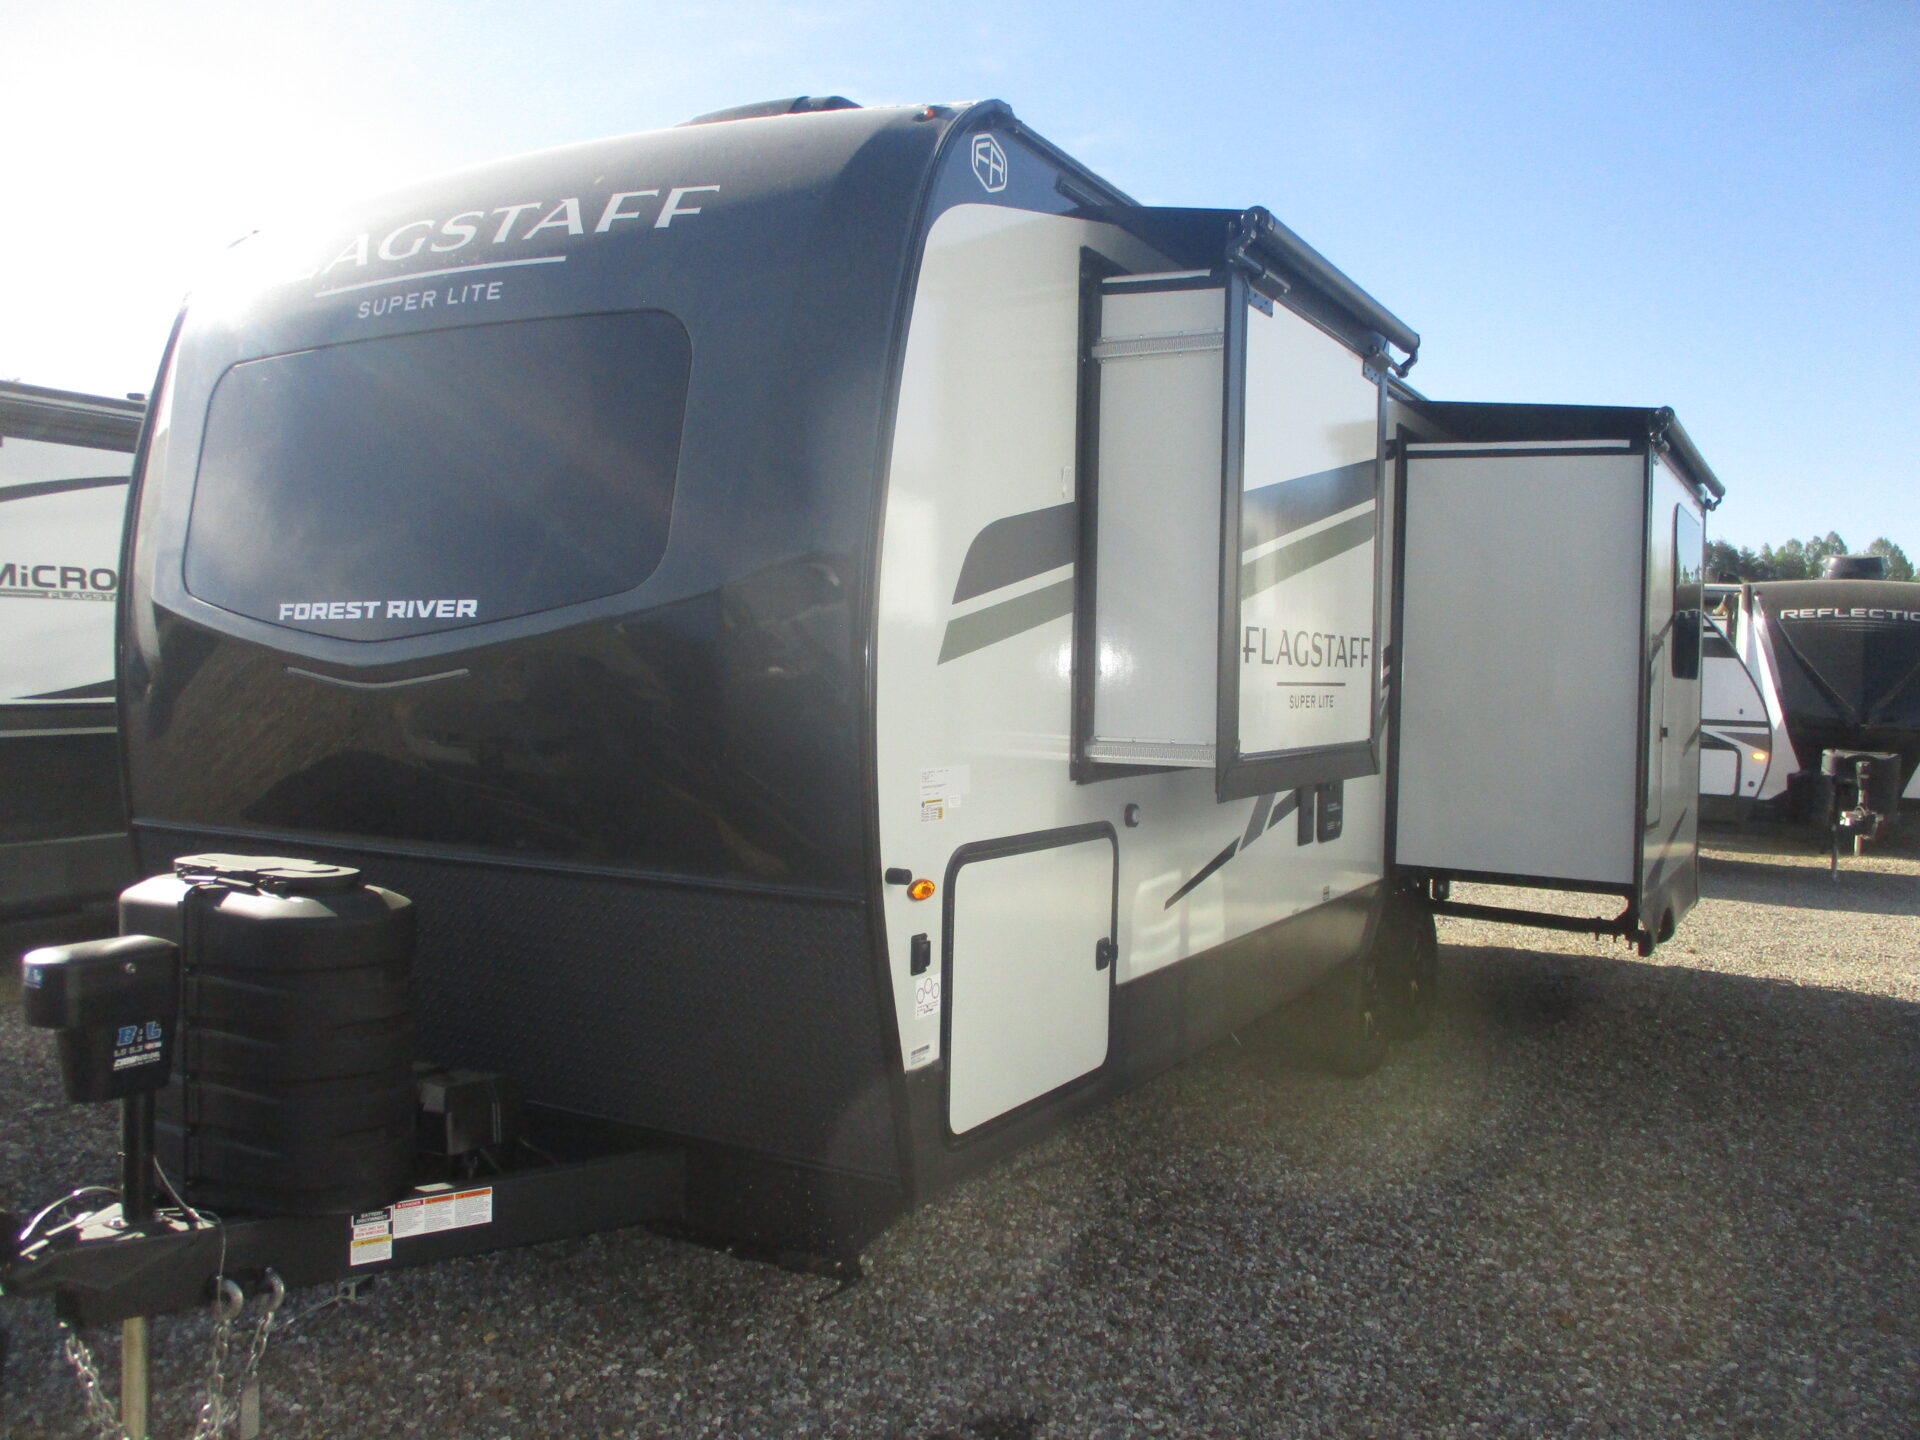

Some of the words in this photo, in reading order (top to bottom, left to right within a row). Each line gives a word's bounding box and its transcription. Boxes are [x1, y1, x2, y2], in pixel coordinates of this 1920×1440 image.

[300, 184, 721, 280] AGSTAFF
[357, 289, 438, 319] SUPER
[447, 281, 504, 306] LITE
[279, 601, 381, 621] FOREST
[386, 599, 478, 619] RIVER
[1243, 626, 1370, 668] FLAGSTAFF
[1289, 695, 1316, 709] SUPER
[1318, 694, 1335, 709] LITE
